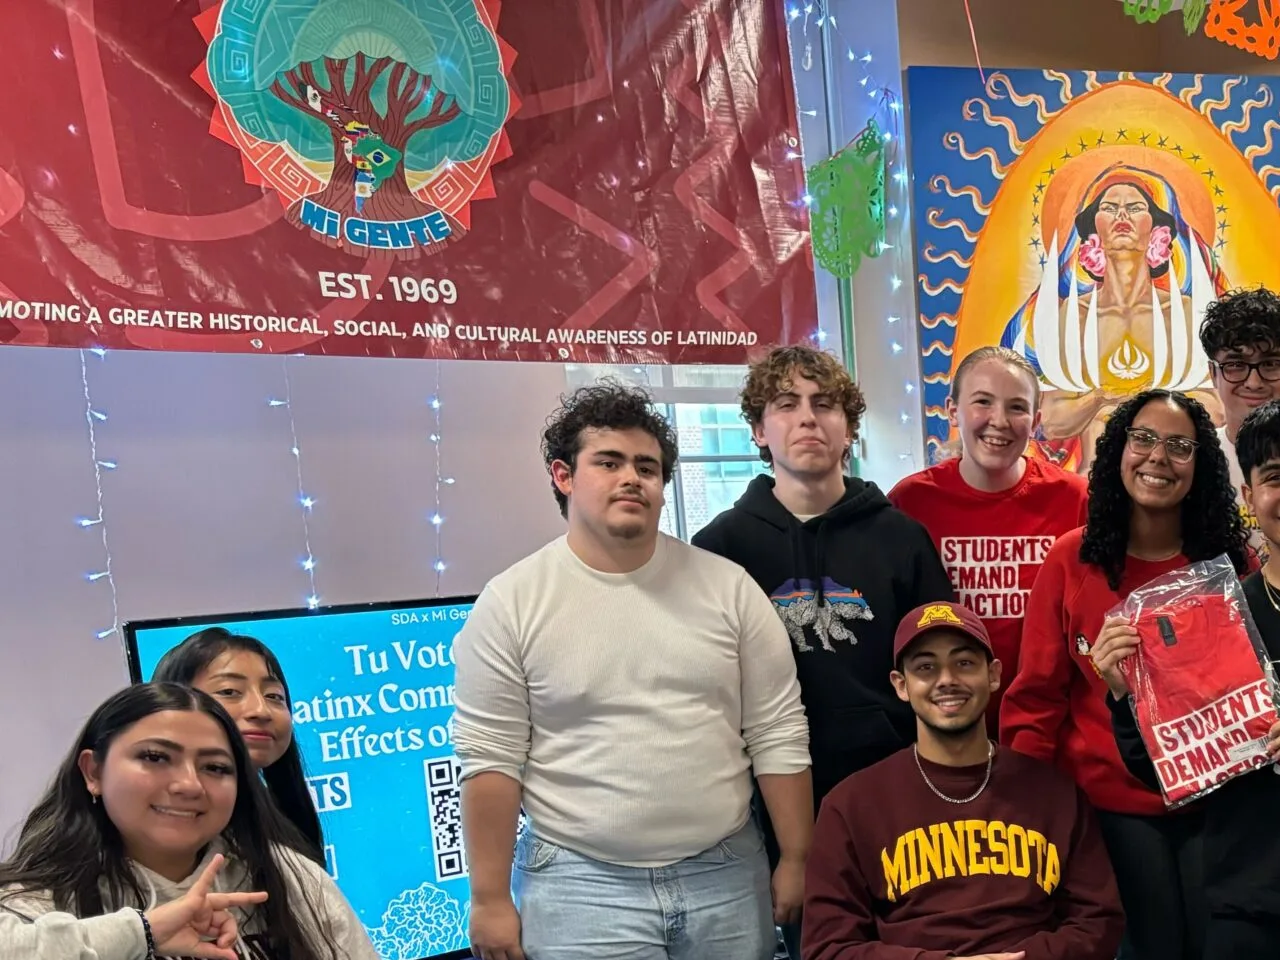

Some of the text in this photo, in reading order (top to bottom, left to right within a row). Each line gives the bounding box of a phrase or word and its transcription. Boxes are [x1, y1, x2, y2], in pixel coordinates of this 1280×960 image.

[344, 210, 452, 249] GENTE
[318, 271, 458, 305] EST. 1969
[86, 306, 103, 324] A
[108, 307, 204, 329] GREATER
[209, 312, 329, 337] HISTORICAL,
[334, 319, 407, 339] SOCIAL,
[412, 322, 450, 339] AND
[455, 324, 542, 343] CULTURAL
[546, 328, 647, 345] AWARENESS
[651, 331, 673, 345] OF
[677, 331, 758, 346] LATINIDAD
[943, 538, 1053, 562] STUDENTS
[947, 565, 1016, 590] EMAND
[391, 612, 419, 626] SDA
[421, 613, 429, 623] x
[344, 644, 389, 677] Tu
[292, 689, 376, 725] atinx
[1157, 680, 1274, 753] STUDENTS
[319, 724, 424, 762] Effects
[309, 775, 347, 809] TS
[881, 819, 1061, 902] MINNESOTA
